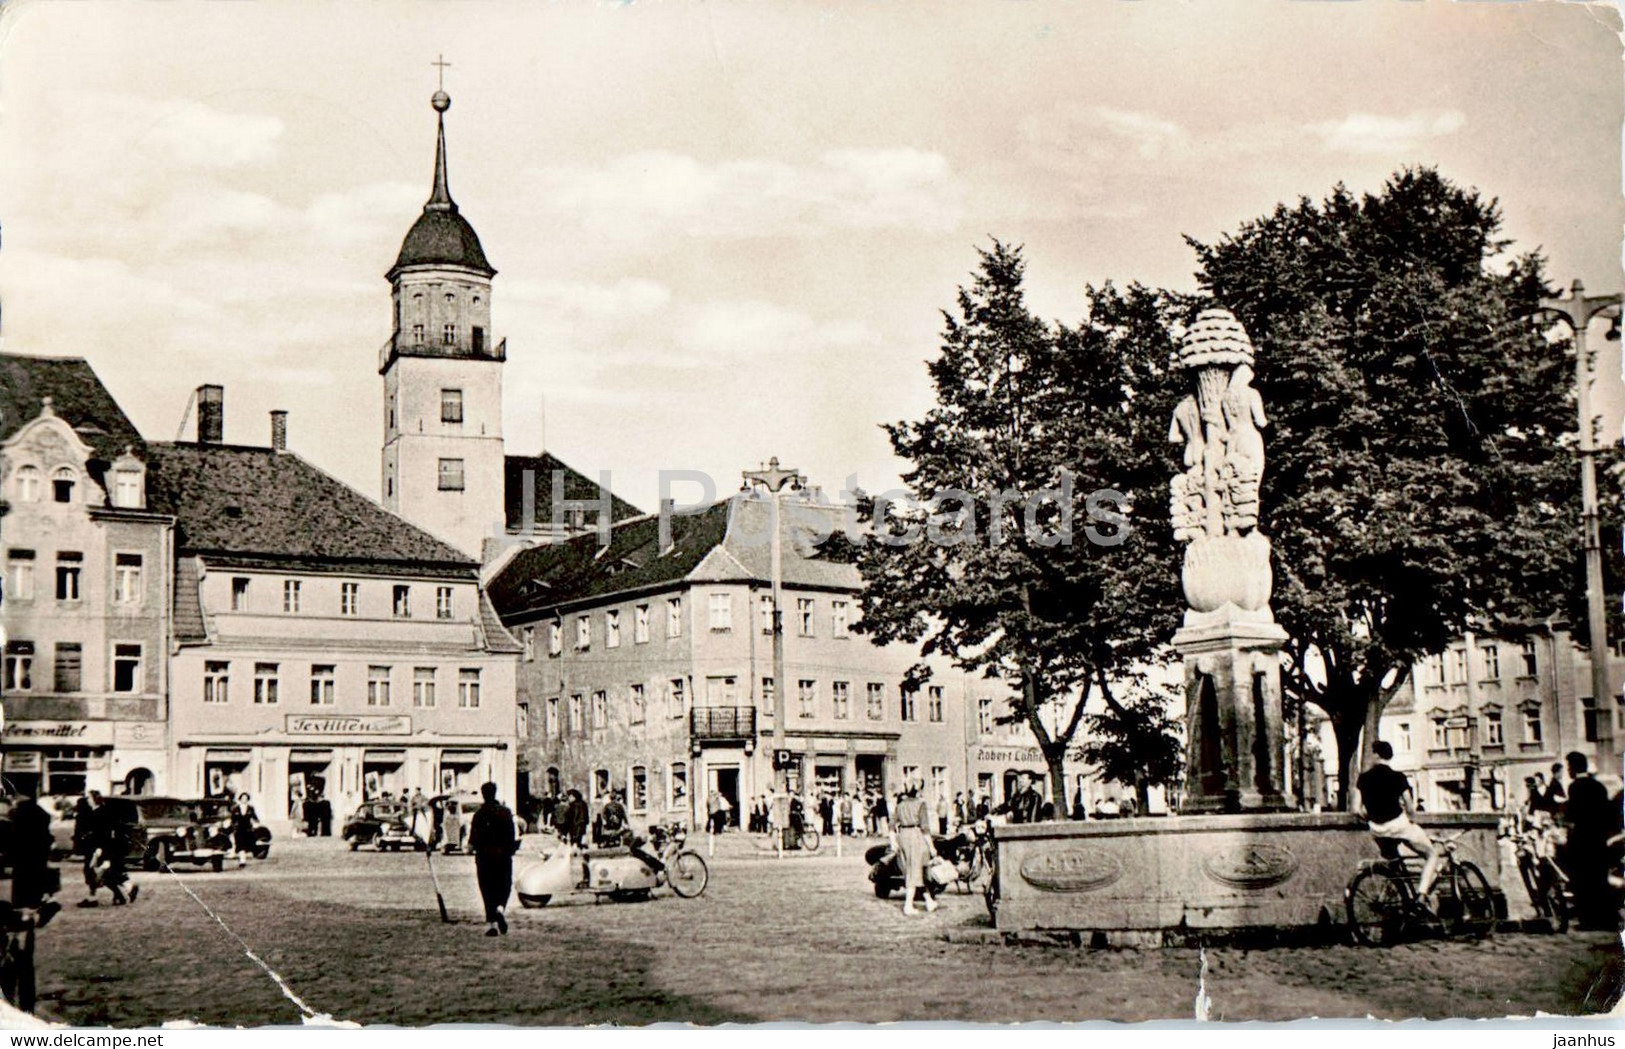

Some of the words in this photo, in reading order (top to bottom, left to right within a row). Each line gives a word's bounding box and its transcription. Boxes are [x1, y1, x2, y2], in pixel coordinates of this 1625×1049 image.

[293, 717, 371, 731] Textilien
[778, 751, 790, 762] P
[977, 748, 1012, 761] Robert
